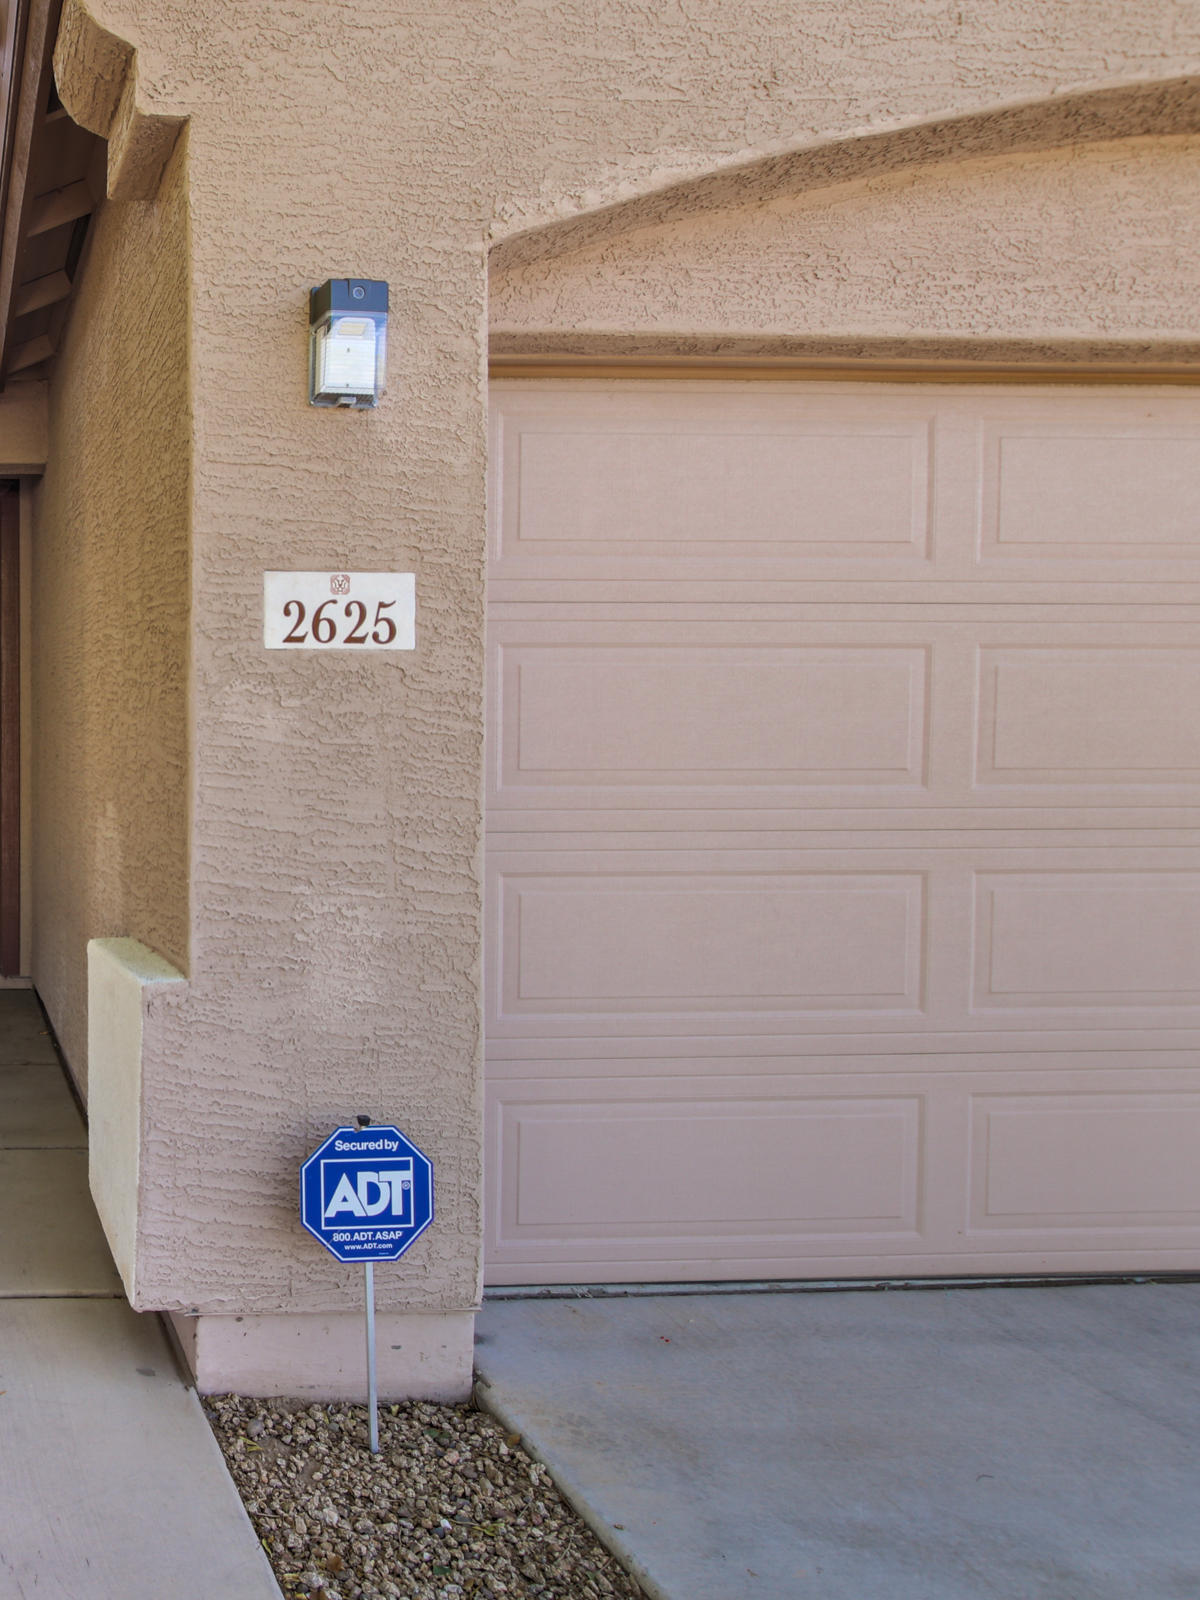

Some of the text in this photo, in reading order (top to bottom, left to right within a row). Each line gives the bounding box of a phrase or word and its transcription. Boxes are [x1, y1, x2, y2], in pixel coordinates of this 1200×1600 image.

[282, 599, 397, 644] 2625
[334, 1139, 399, 1152] Secured by
[324, 1170, 412, 1217] ADT
[332, 1231, 403, 1242] 800.ADT.ASAP
